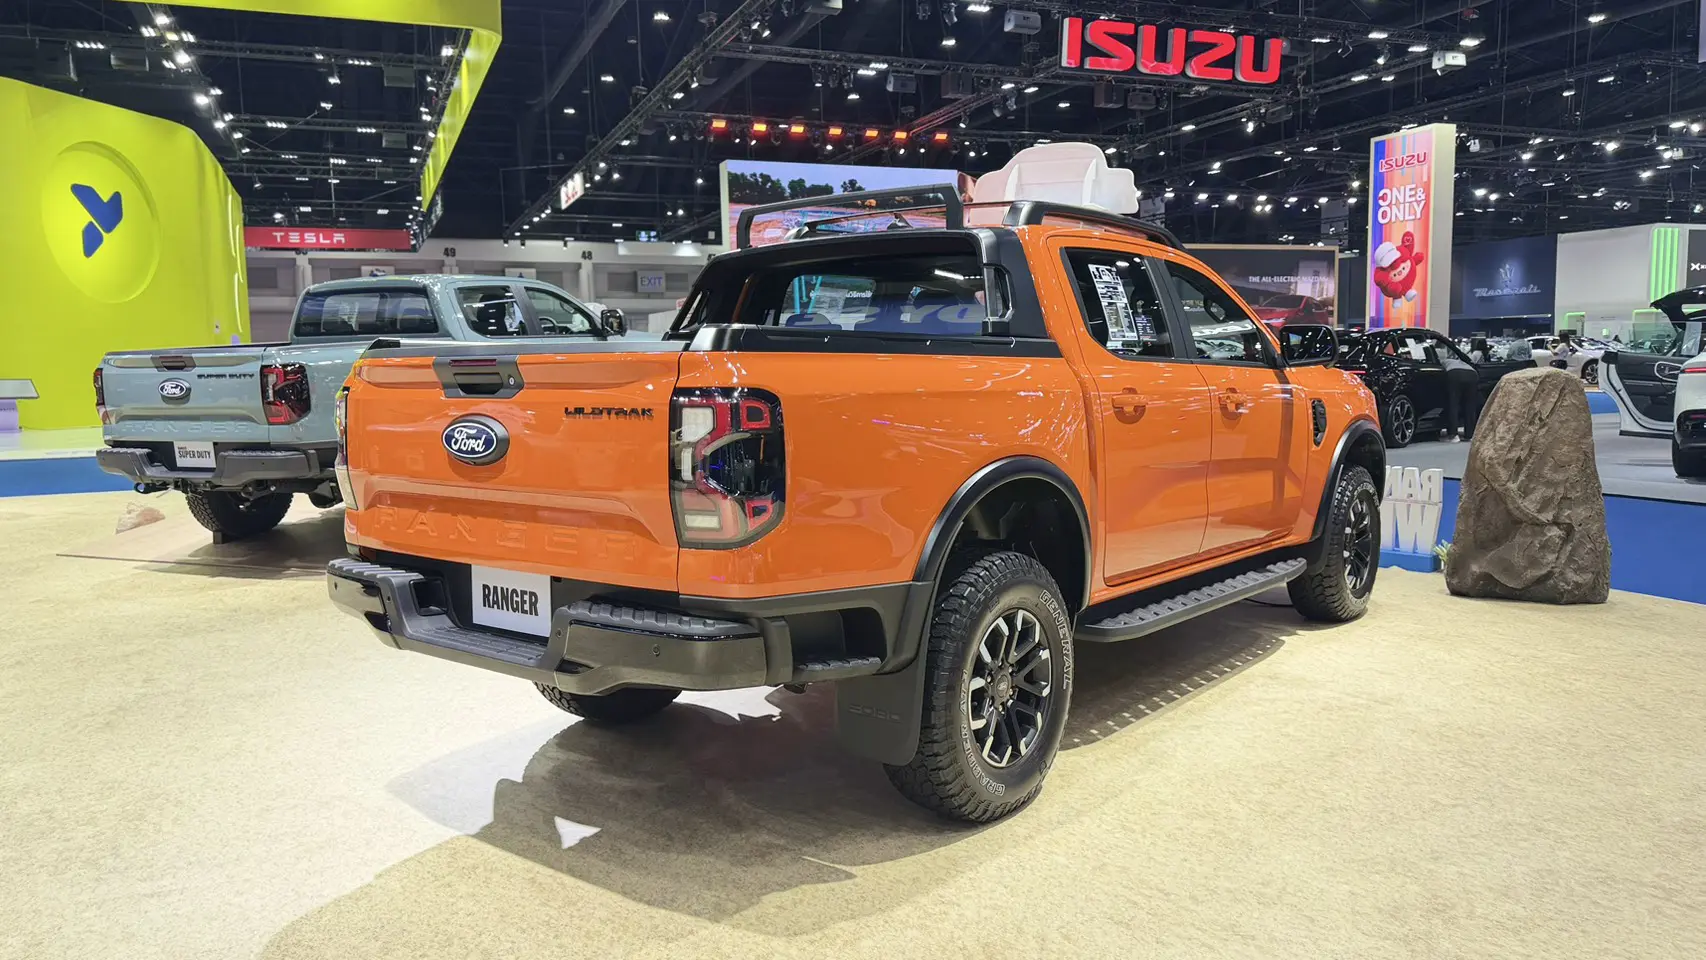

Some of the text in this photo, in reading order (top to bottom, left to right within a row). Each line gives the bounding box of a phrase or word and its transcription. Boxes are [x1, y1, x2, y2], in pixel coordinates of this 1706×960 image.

[1061, 17, 1282, 84] ISUZU
[1379, 152, 1427, 172] ISUZU
[1377, 200, 1426, 224] ONLY
[272, 232, 347, 243] TESLA
[443, 248, 456, 257] 49
[581, 251, 593, 260] 48
[640, 277, 663, 286] EXIT
[1473, 284, 1541, 297] Maserati
[162, 383, 182, 395] Ford
[564, 406, 654, 418] WILDTRAK
[451, 428, 487, 452] Ford
[178, 450, 212, 459] SUPER DUTY
[373, 504, 636, 560] RANGER
[482, 583, 539, 617] RANGER
[1039, 589, 1073, 690] GENERAL
[960, 722, 1005, 796] GRABBER
